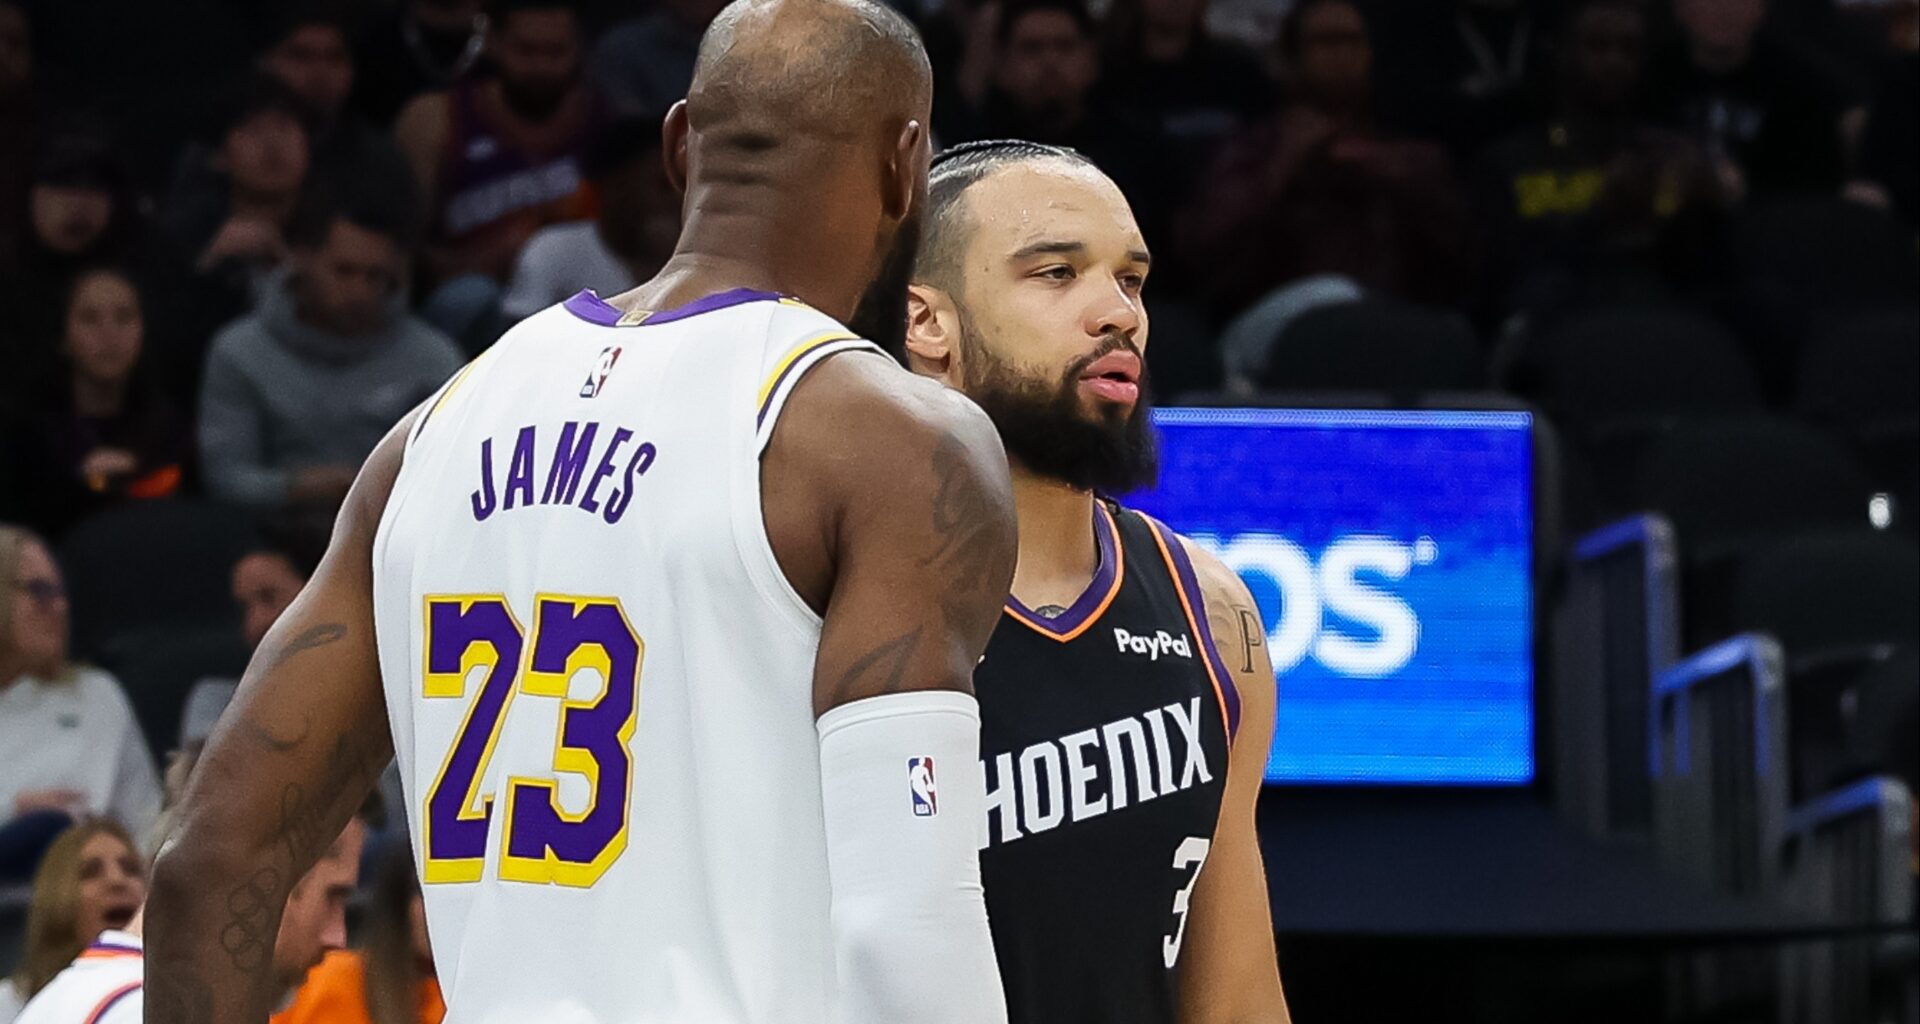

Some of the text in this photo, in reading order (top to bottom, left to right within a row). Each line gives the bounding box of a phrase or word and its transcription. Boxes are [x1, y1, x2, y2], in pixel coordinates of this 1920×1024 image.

[471, 421, 657, 524] JAMES
[1113, 627, 1192, 661] PayPal
[1190, 531, 1423, 679] OS
[423, 592, 645, 889] 23
[979, 697, 1213, 850] HOENIX
